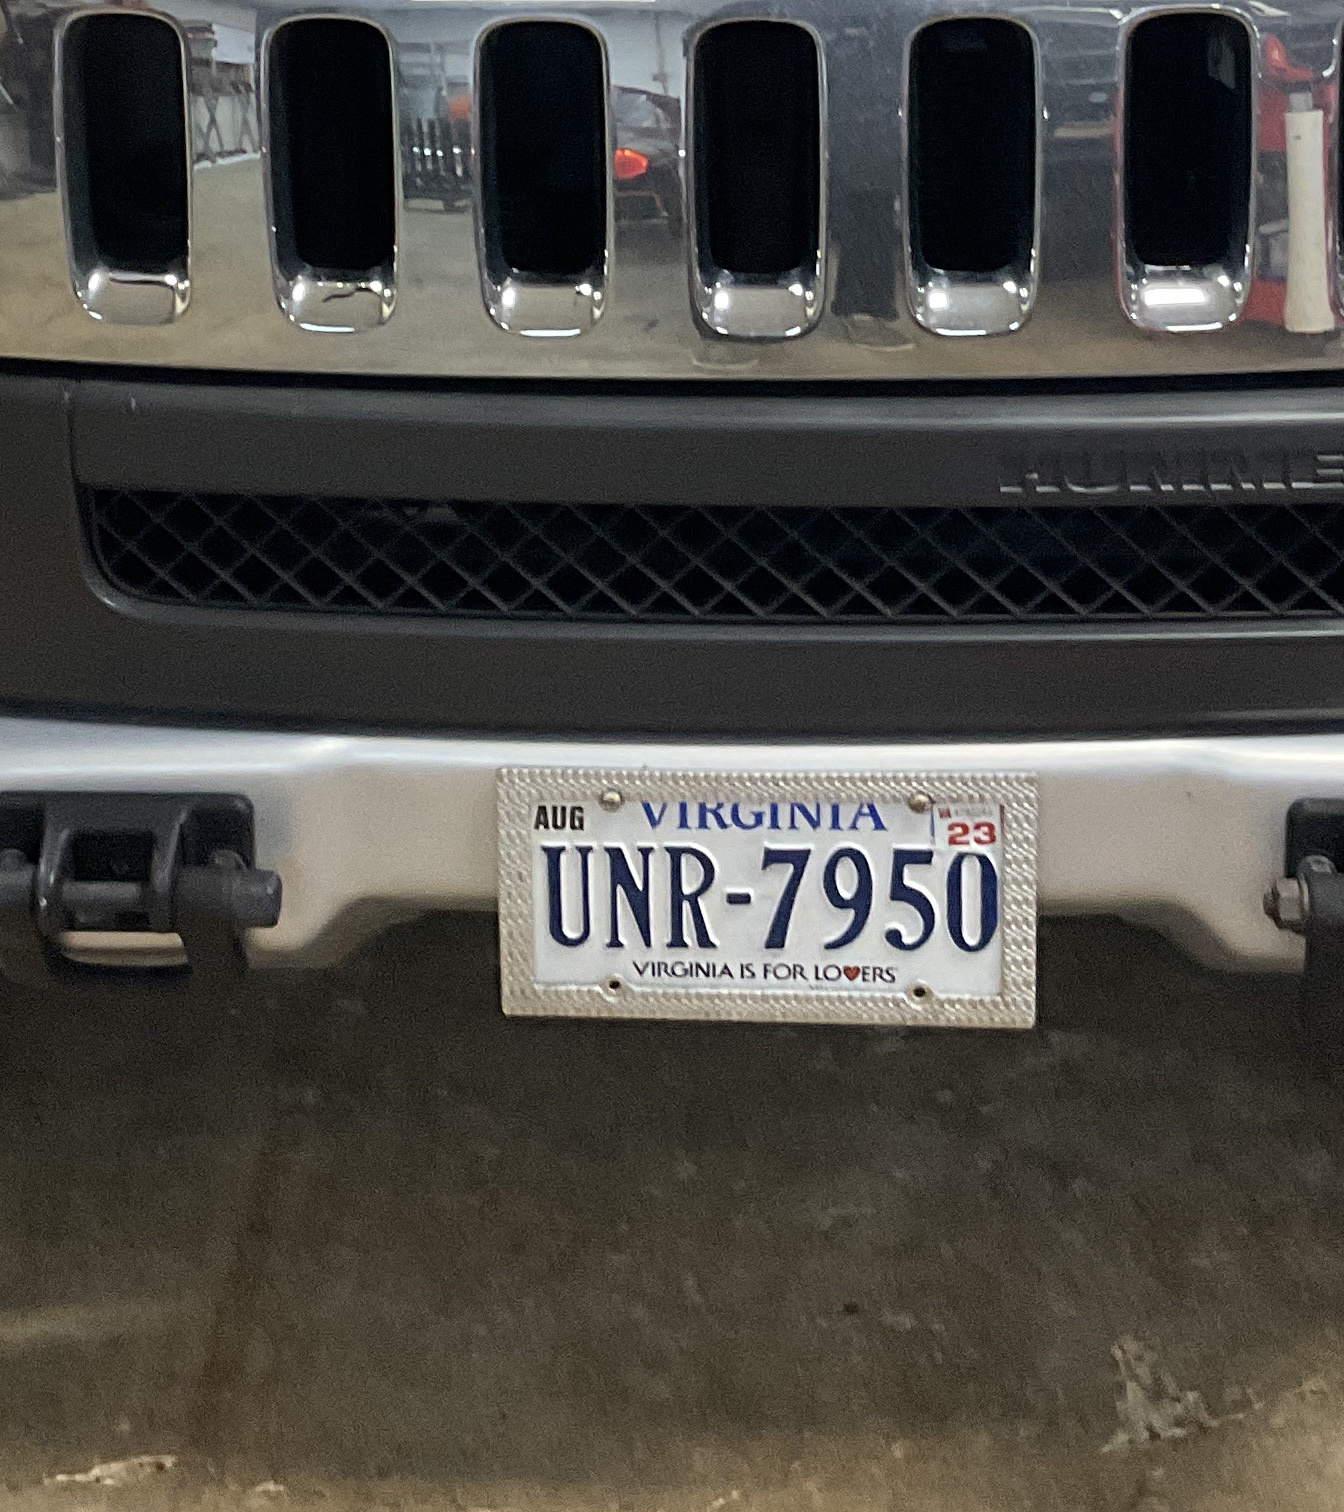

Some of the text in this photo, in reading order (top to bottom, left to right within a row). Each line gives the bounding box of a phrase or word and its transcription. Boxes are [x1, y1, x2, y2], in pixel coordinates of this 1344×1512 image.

[533, 804, 585, 831] AUG
[639, 801, 889, 832] VIRGINIA
[947, 821, 997, 846] 23
[540, 843, 1000, 953] UNR-7950
[632, 960, 735, 980] VIRGINIA
[739, 962, 757, 980] IS
[762, 962, 809, 982] FOR
